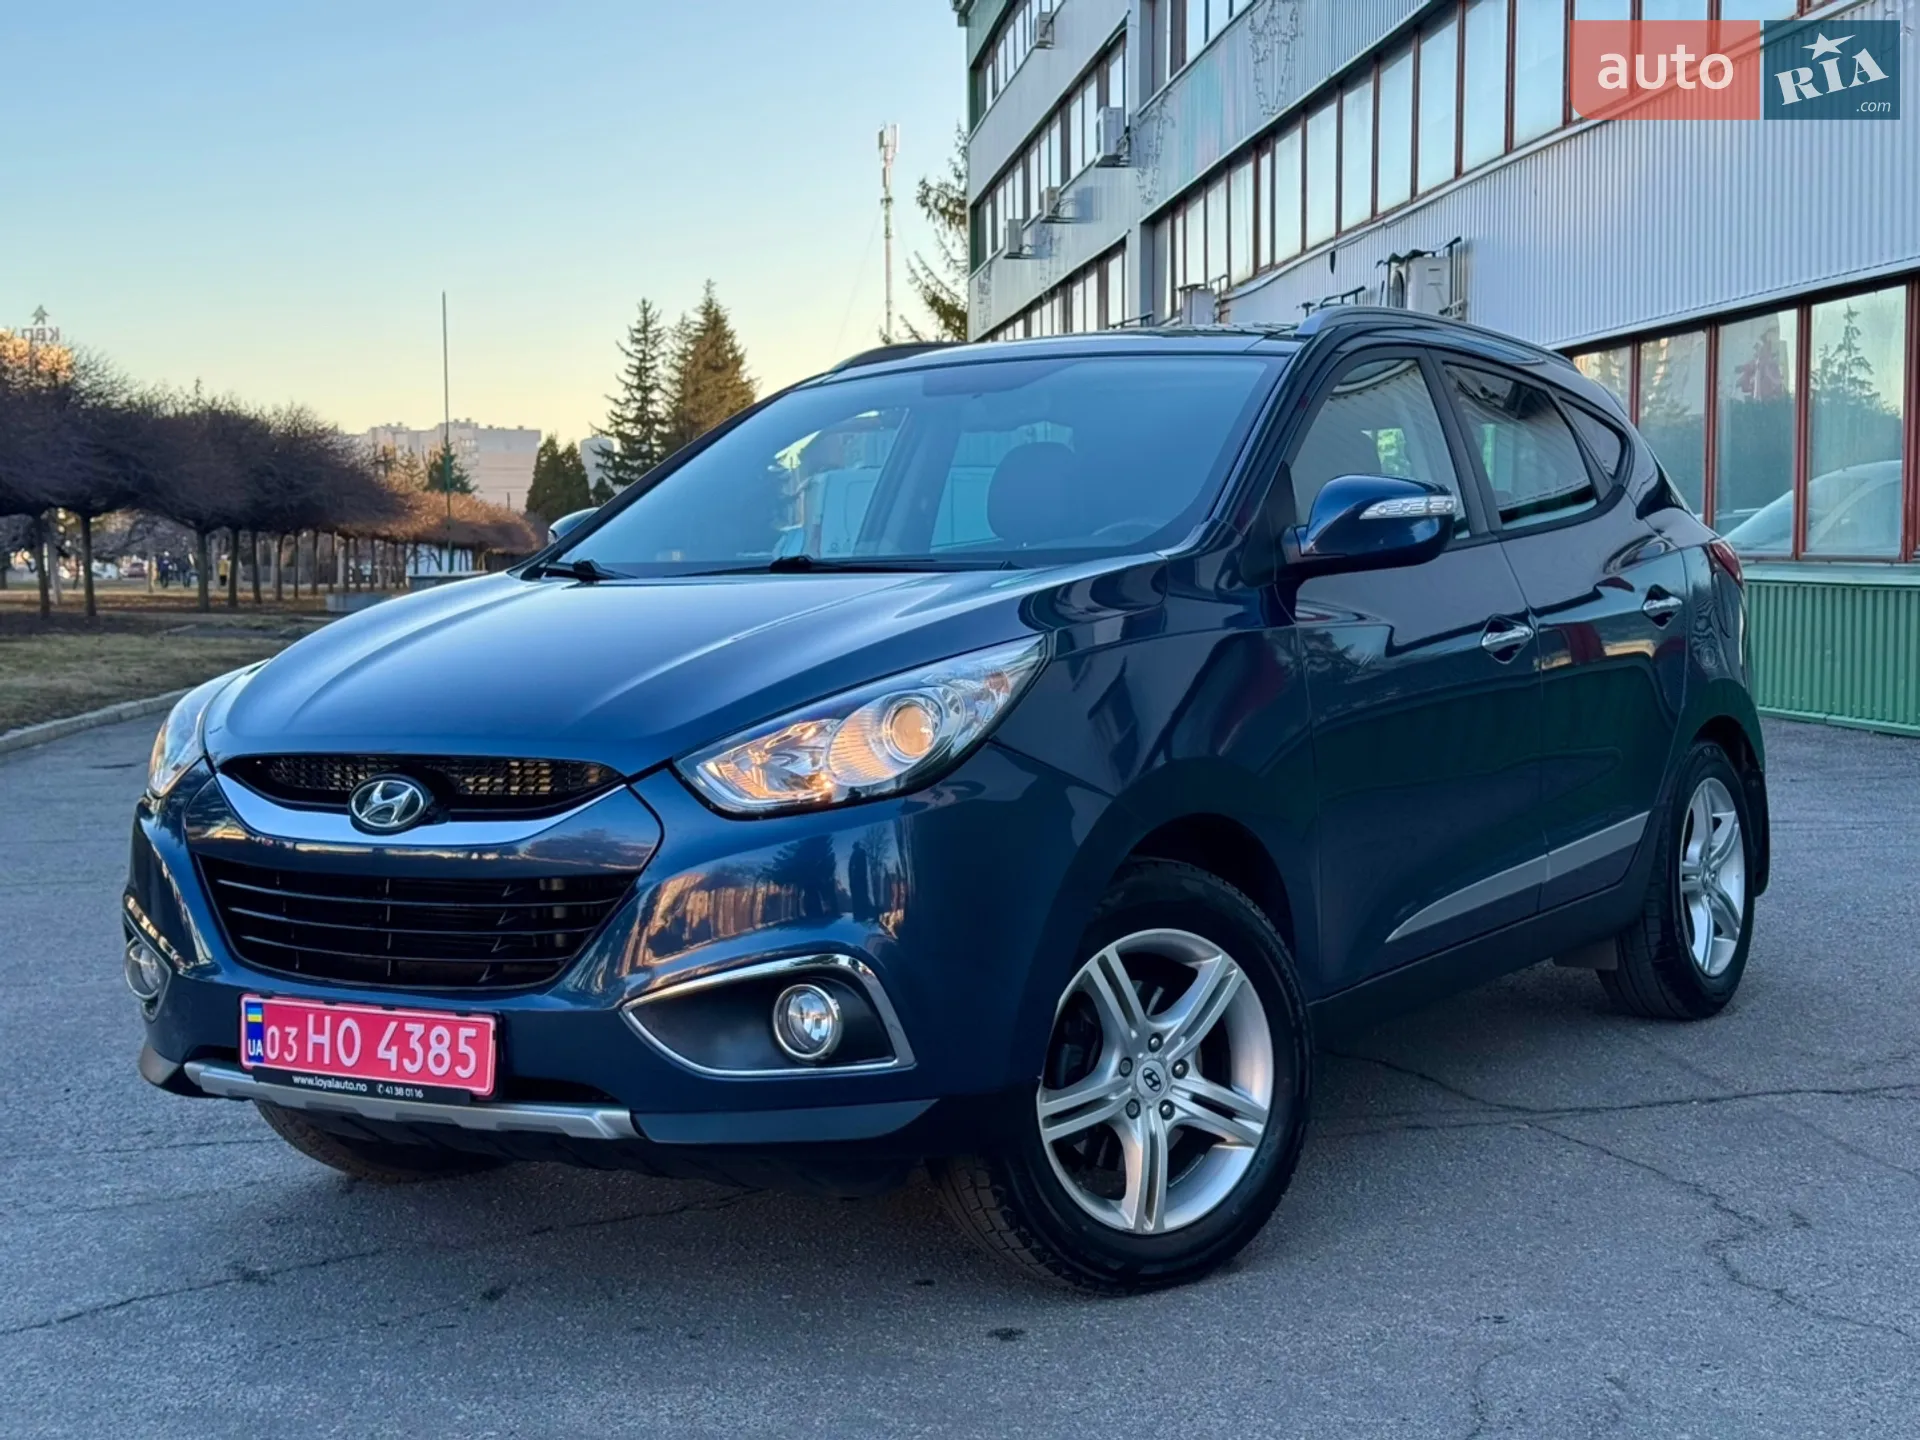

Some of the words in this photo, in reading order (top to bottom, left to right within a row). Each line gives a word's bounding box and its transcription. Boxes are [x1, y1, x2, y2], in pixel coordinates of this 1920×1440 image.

[247, 1037, 264, 1057] UA
[266, 1025, 298, 1063] 03
[377, 1020, 478, 1080] 4385
[292, 1075, 367, 1092] www.loyalauto.no
